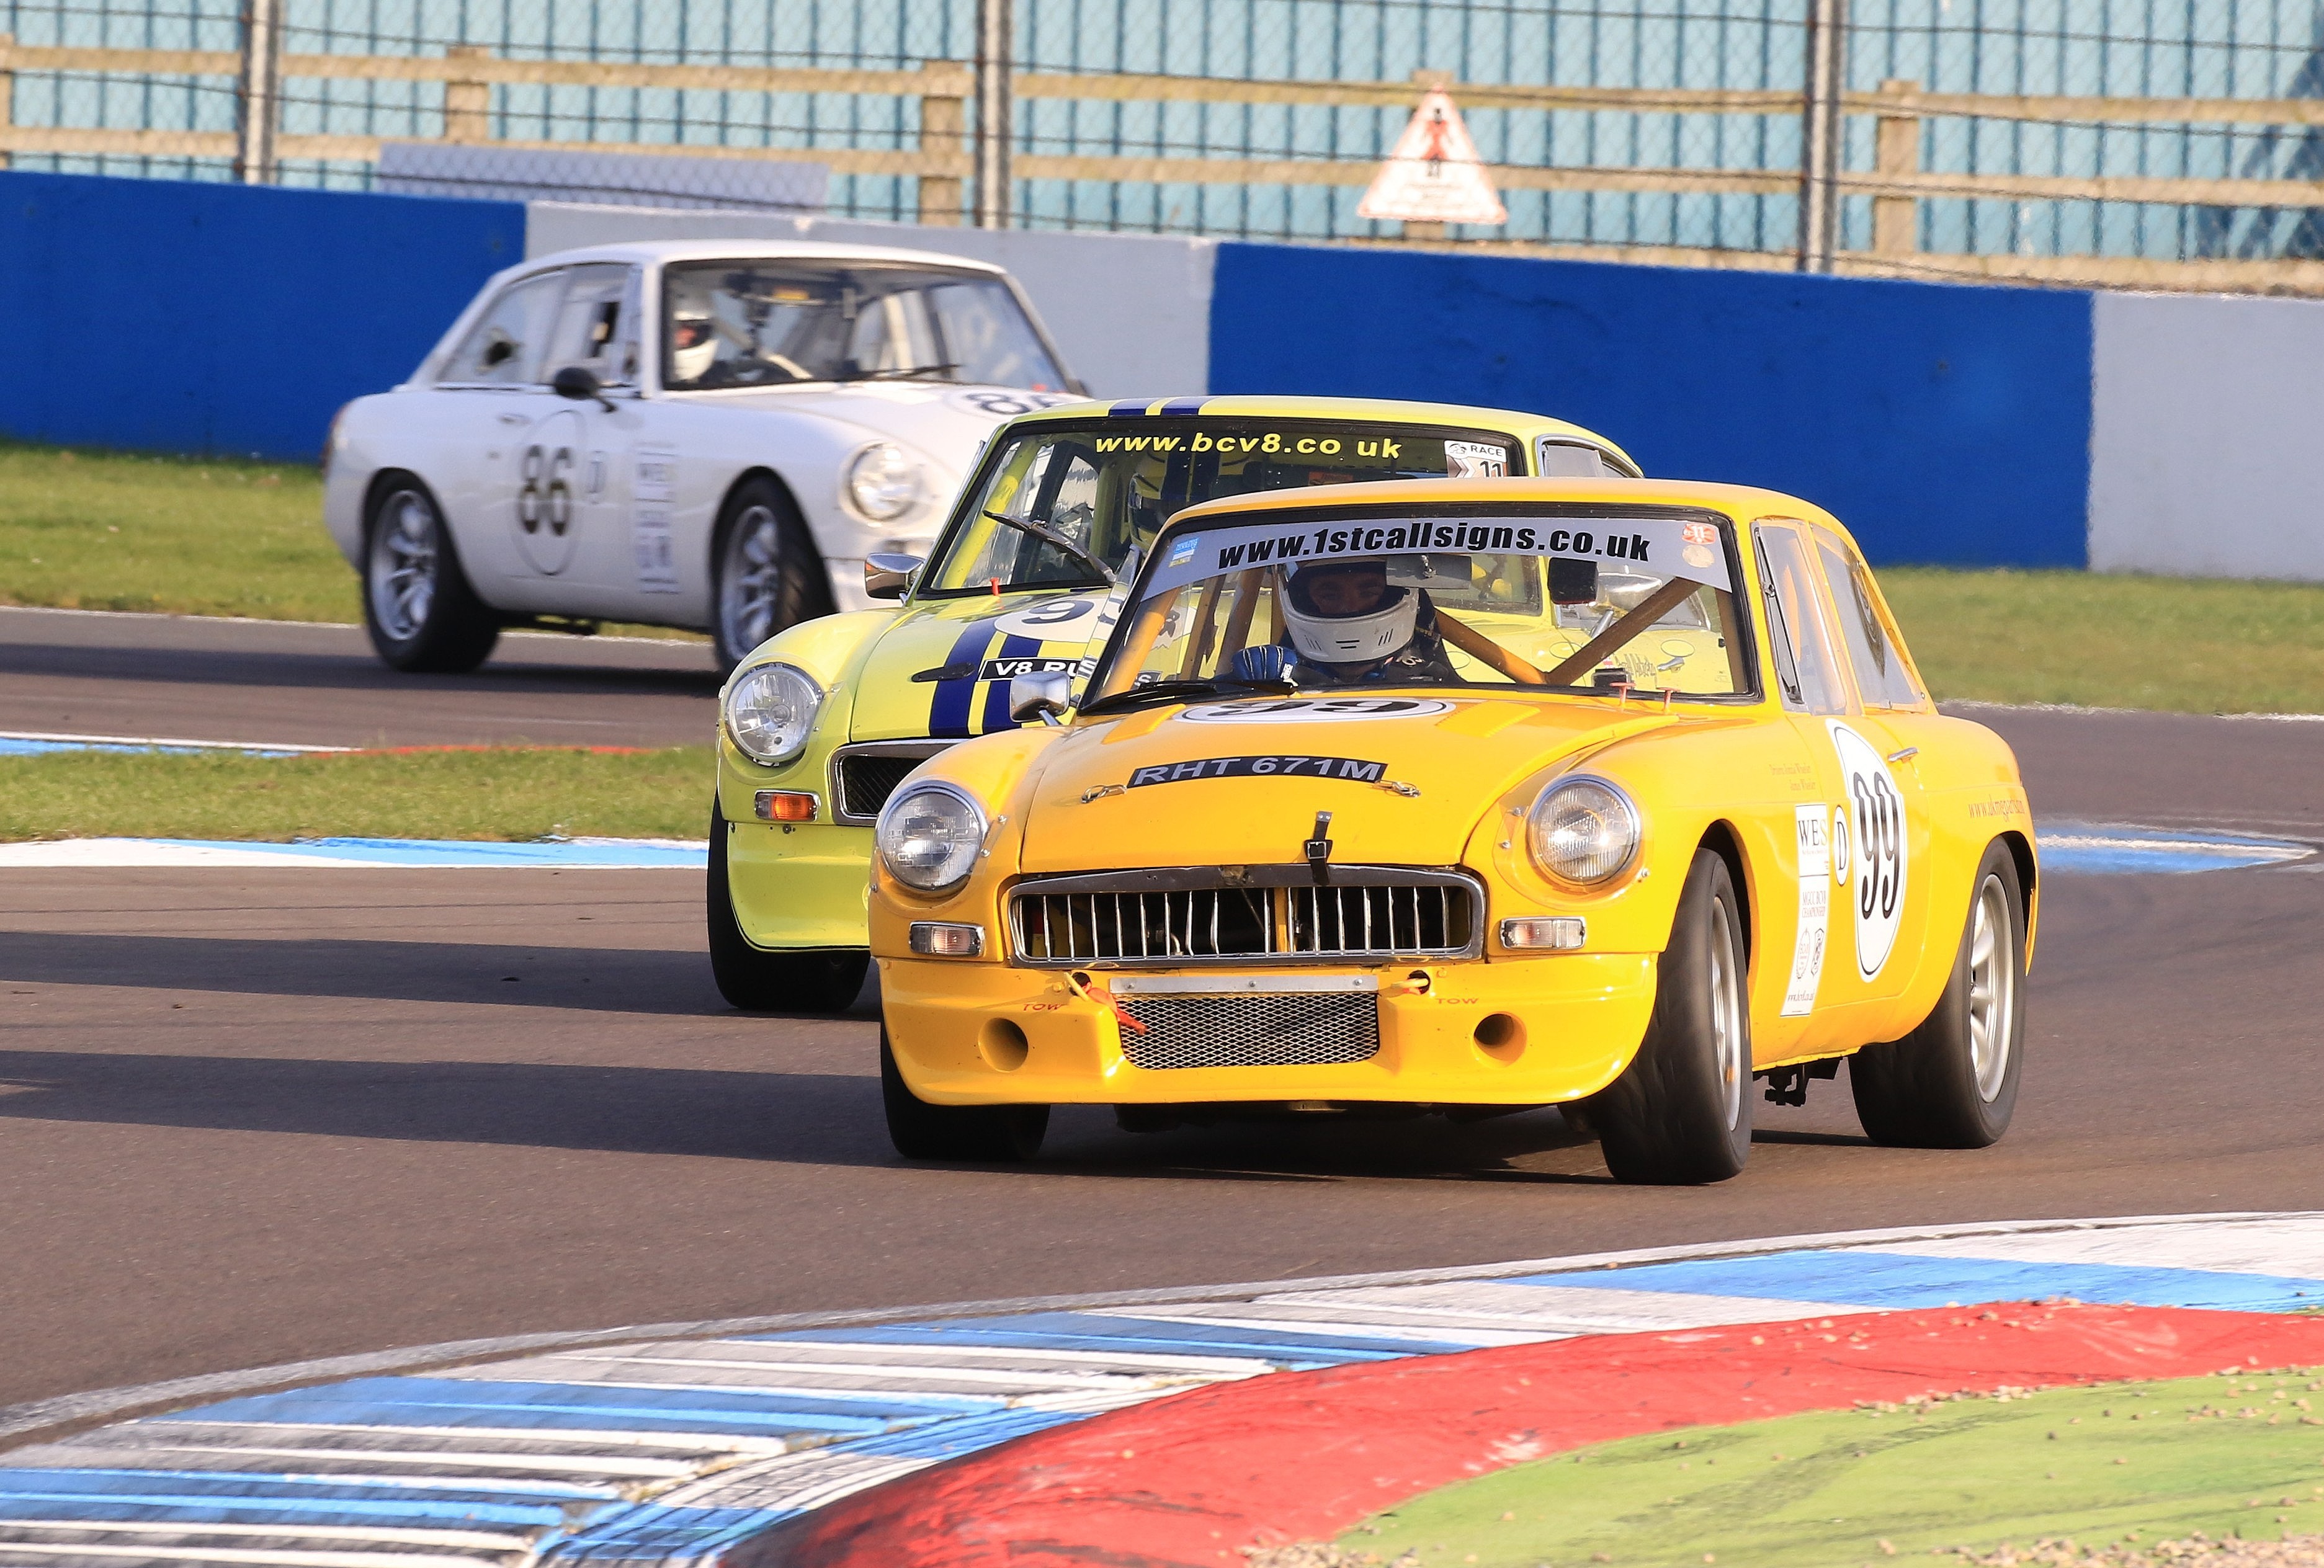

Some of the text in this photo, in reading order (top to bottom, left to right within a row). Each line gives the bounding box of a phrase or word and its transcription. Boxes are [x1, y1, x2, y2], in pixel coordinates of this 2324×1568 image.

[1356, 437, 1402, 460] uk
[1470, 445, 1503, 457] RACE
[519, 443, 574, 537] 86
[1218, 521, 1651, 569] www.1stcallsigns.co.uk
[995, 661, 1034, 675] V8
[1207, 700, 1421, 717] 99
[1134, 757, 1382, 785] RHT 671M
[1798, 819, 1828, 847] WES
[1836, 821, 1848, 871] D
[1853, 771, 1900, 920] 99
[1022, 1003, 1063, 1012] TOW
